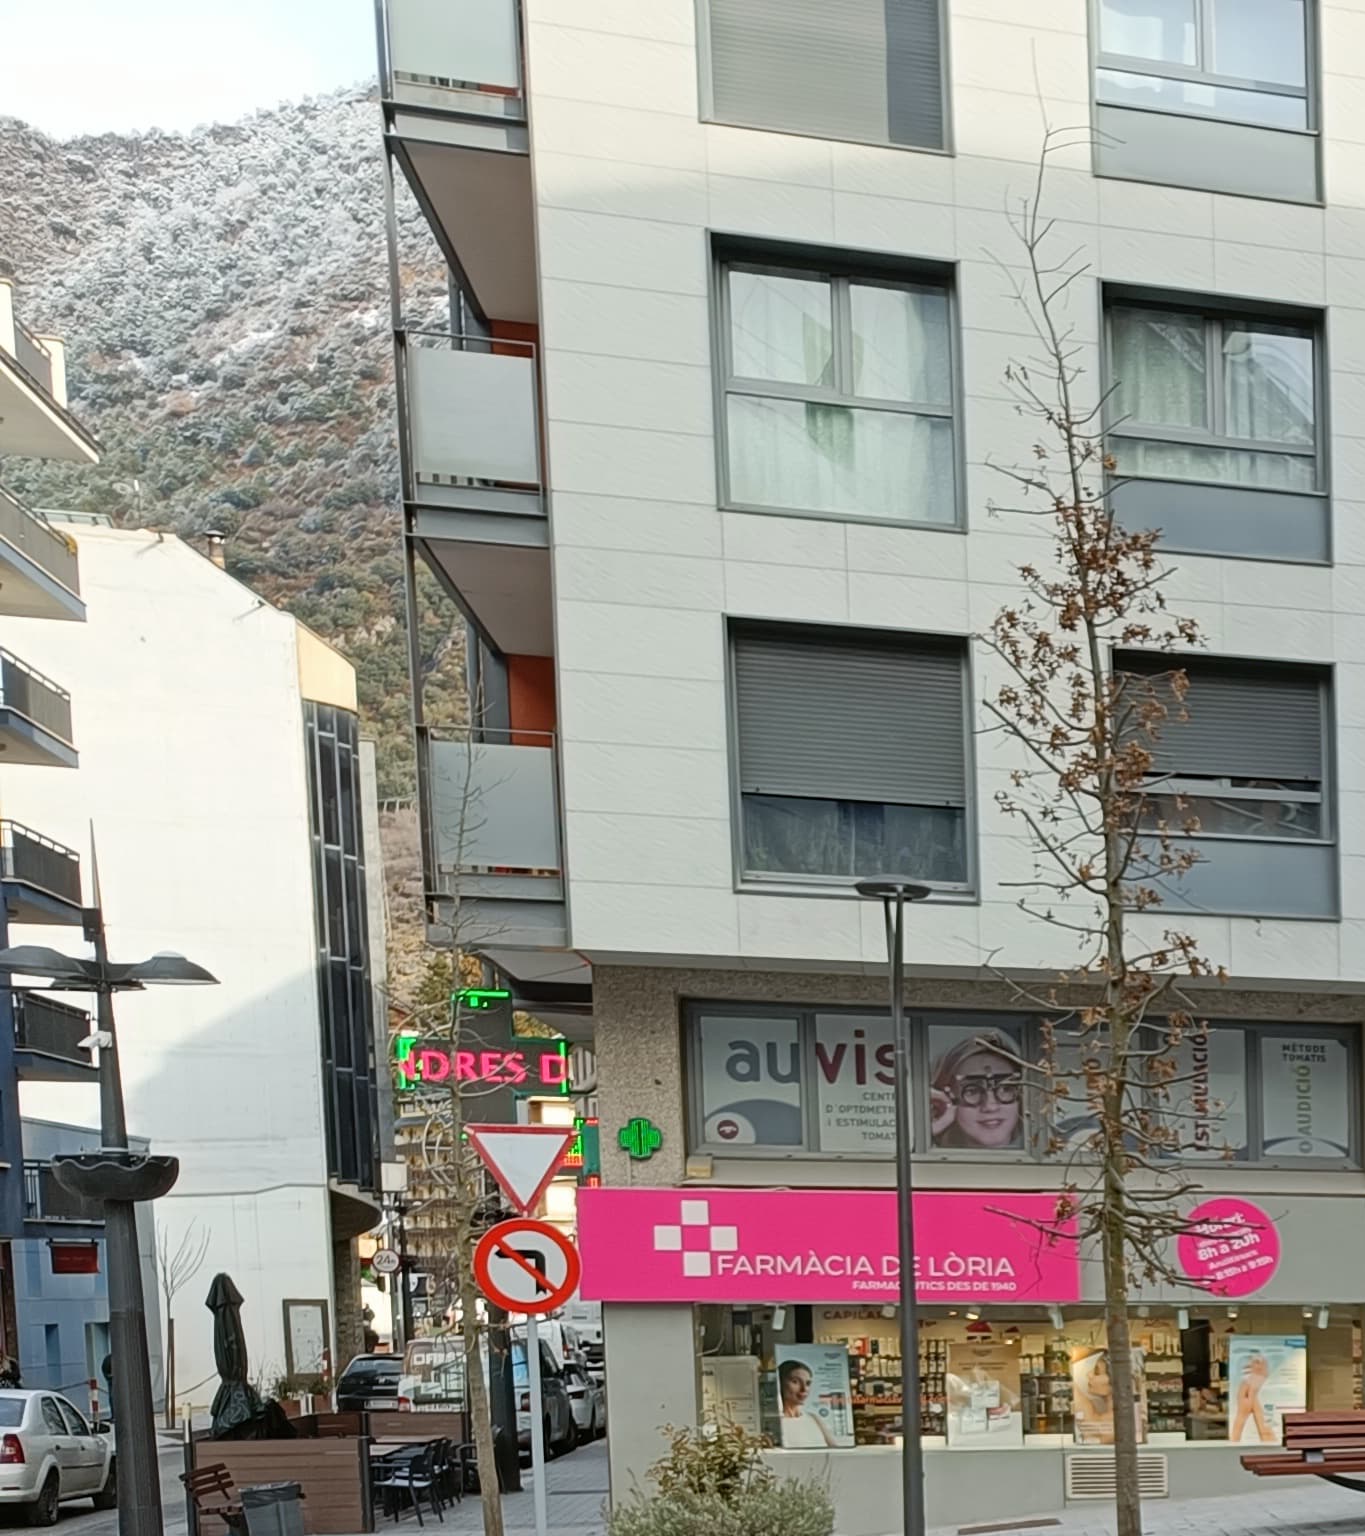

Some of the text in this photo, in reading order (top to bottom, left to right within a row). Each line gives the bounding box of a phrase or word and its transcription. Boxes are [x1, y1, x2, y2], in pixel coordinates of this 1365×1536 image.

[1219, 1243, 1230, 1254] a
[717, 1250, 875, 1277] FARMÀCIA
[928, 1250, 1016, 1277] LÒRIA
[947, 1280, 971, 1291] DES
[973, 1281, 990, 1291] DE
